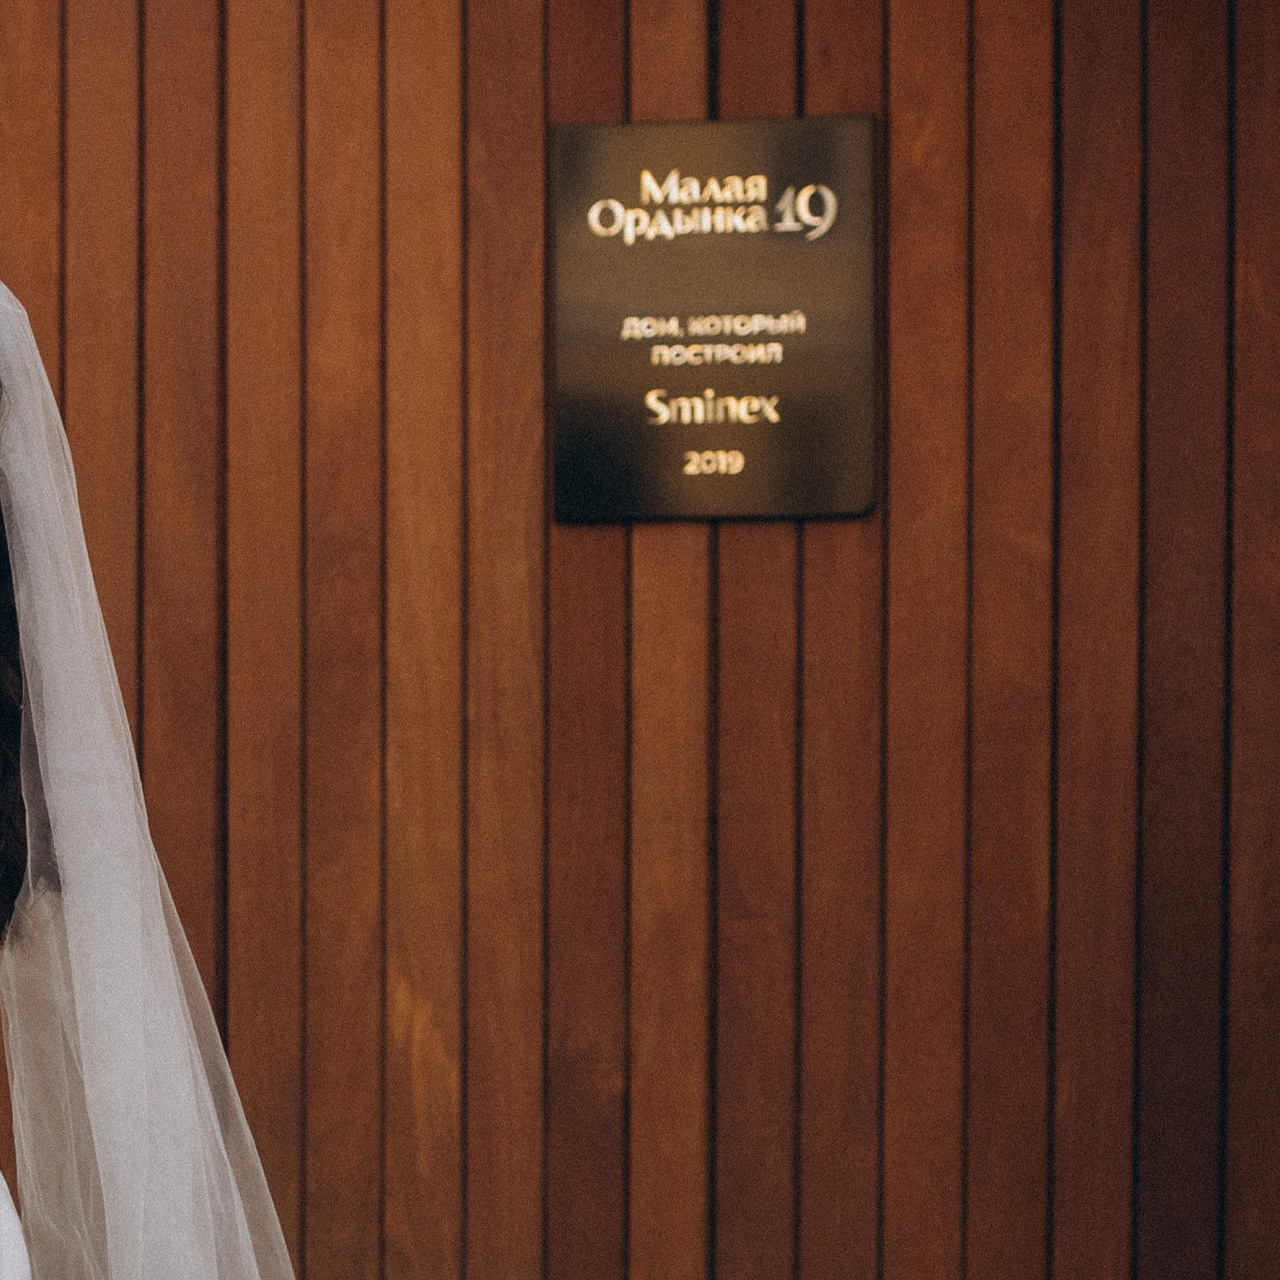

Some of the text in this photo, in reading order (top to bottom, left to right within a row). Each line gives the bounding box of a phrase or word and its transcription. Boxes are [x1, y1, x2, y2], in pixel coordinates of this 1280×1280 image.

[640, 169, 768, 206] Малая
[587, 183, 838, 246] Ордынка 19
[687, 310, 807, 336] КОТОРЫЙ
[650, 342, 784, 366] ПОСТРОИЛ
[644, 387, 781, 425] Sminex
[683, 450, 745, 475] 2019
